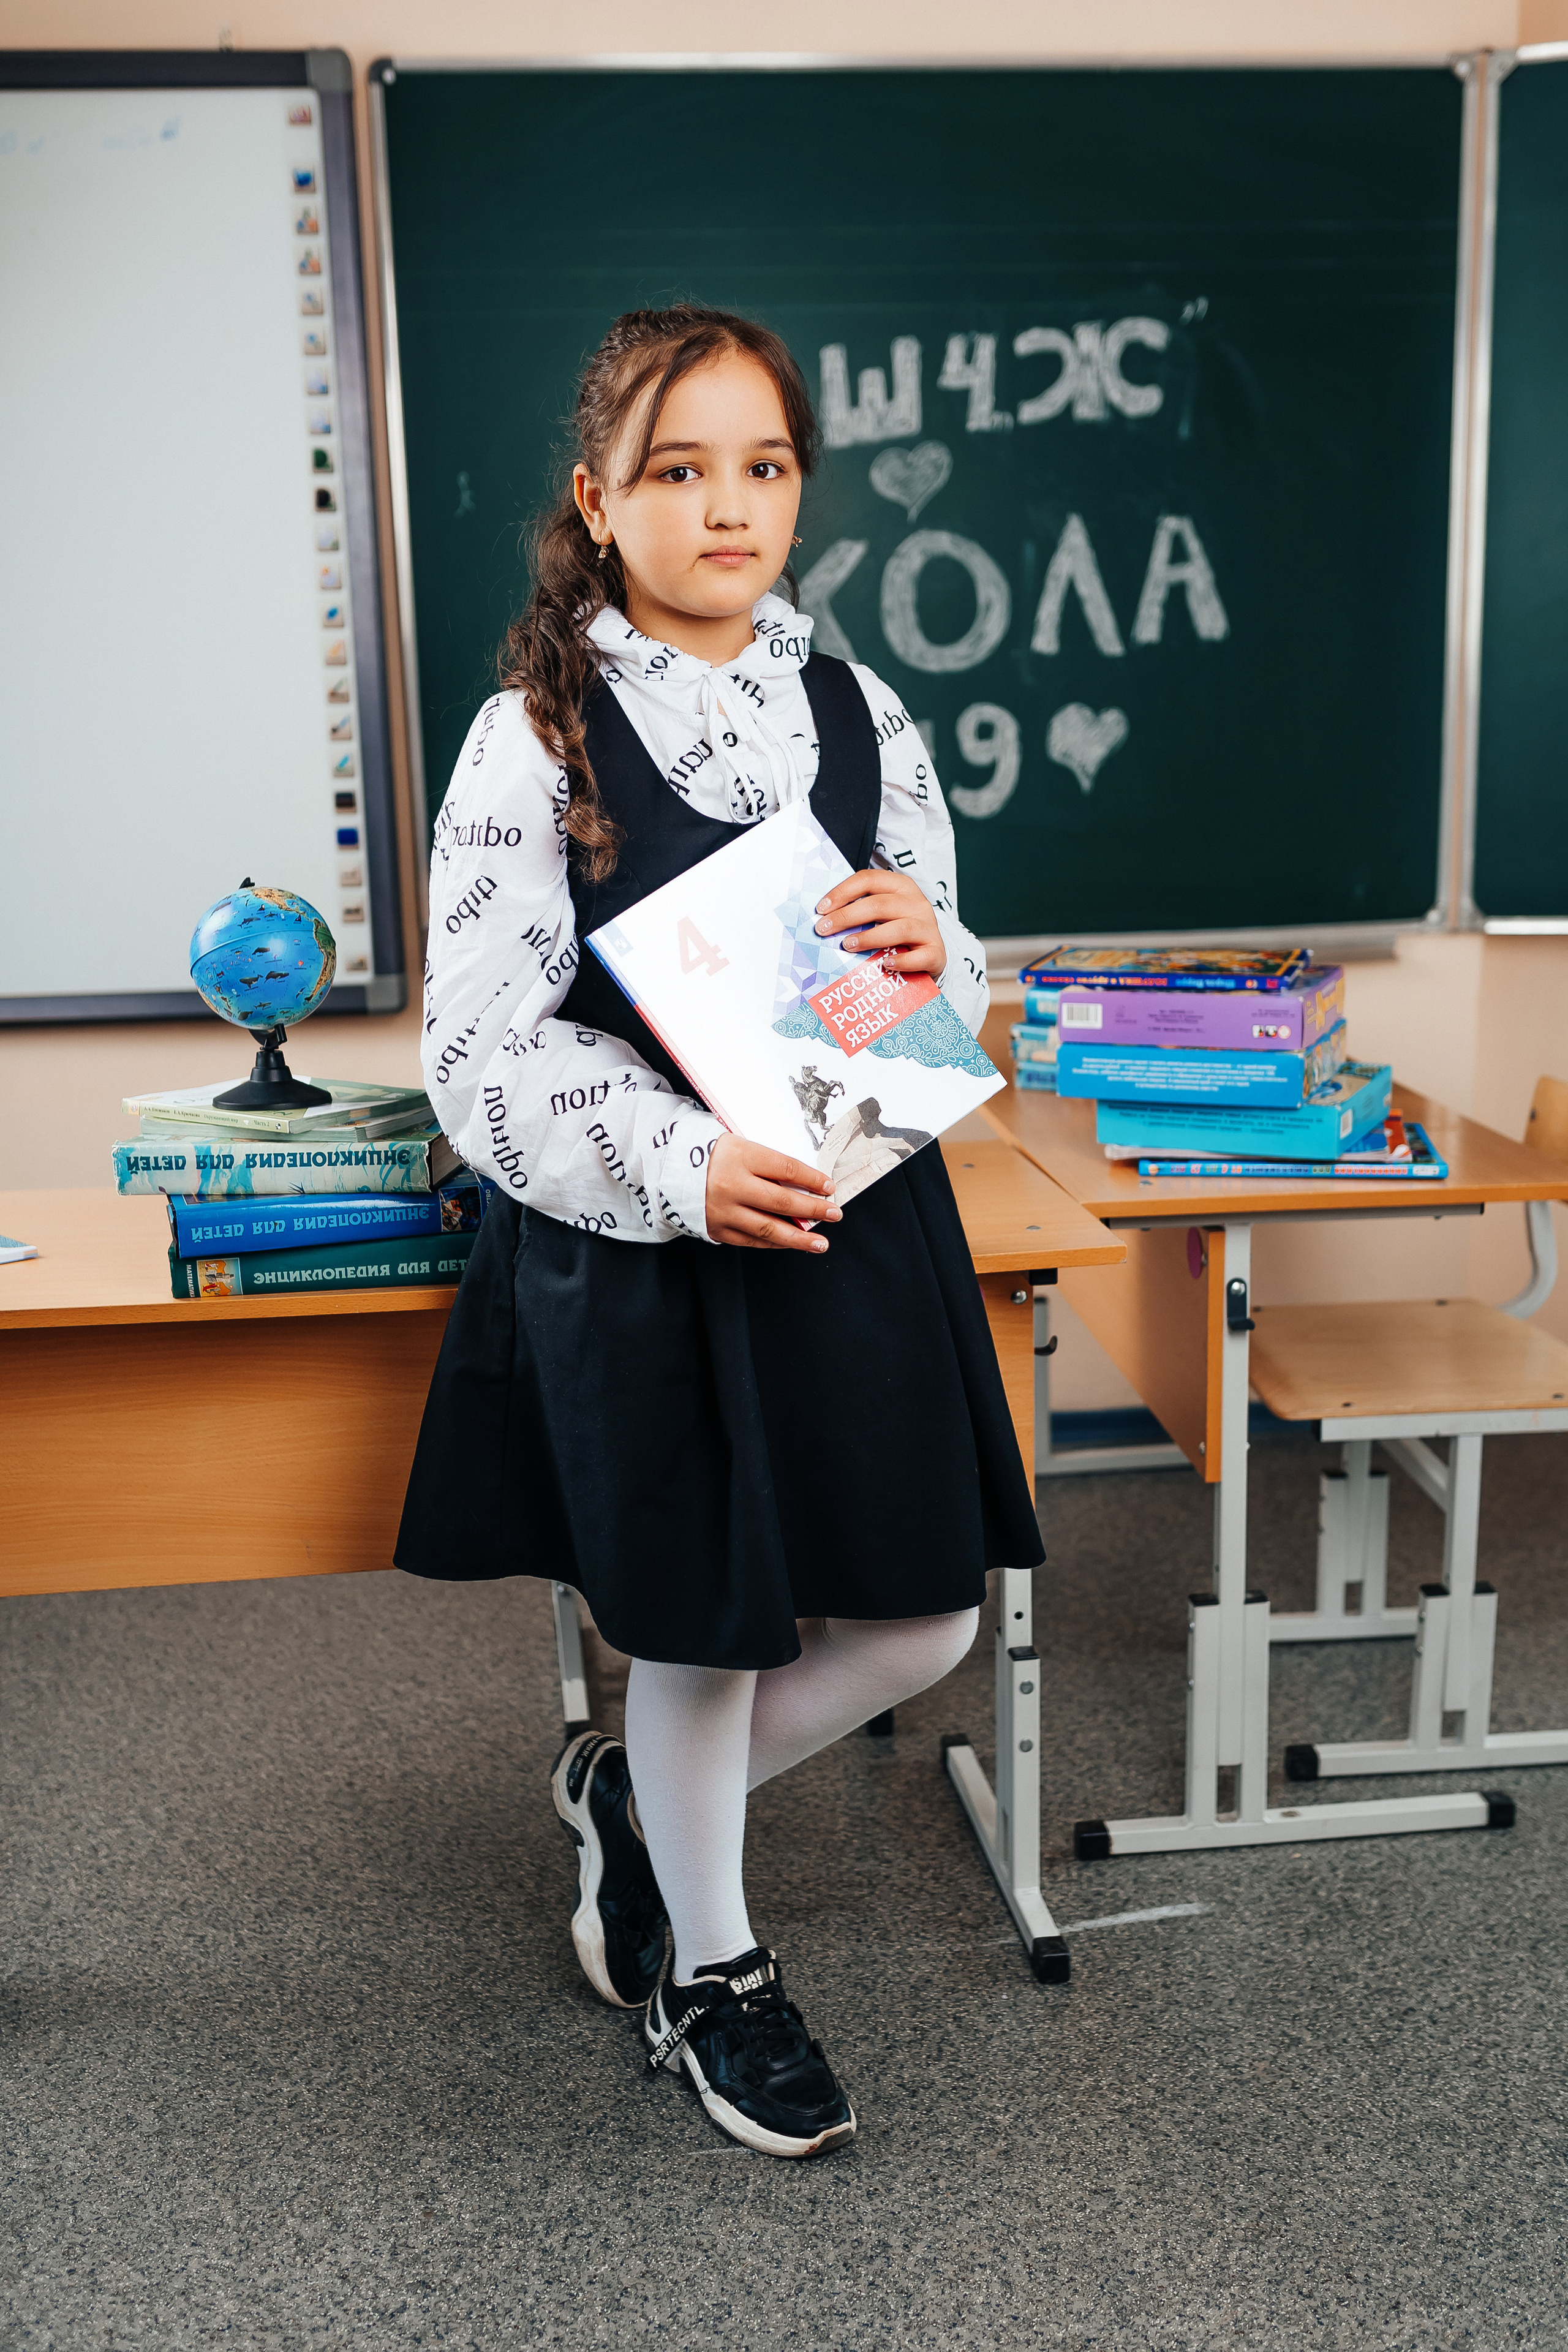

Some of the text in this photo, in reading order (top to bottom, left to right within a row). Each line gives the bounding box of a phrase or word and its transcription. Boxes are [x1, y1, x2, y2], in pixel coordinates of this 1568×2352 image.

[677, 916, 729, 976] 4
[831, 970, 908, 1031] РОДНОЙ
[845, 1003, 899, 1048] ЯЗЫК
[126, 1149, 410, 1174] ЭНЦИКЛОПЕДИЯ ДЛЯ ДЕТЕЙ
[192, 1205, 429, 1242] ЭНЦИКЛОПЕДИЯ ДЛЯ ДЕТЕЙ
[253, 1264, 390, 1285] ЭНЦИКЛОПЕДИЯ
[398, 1261, 430, 1276] ДЛЯ
